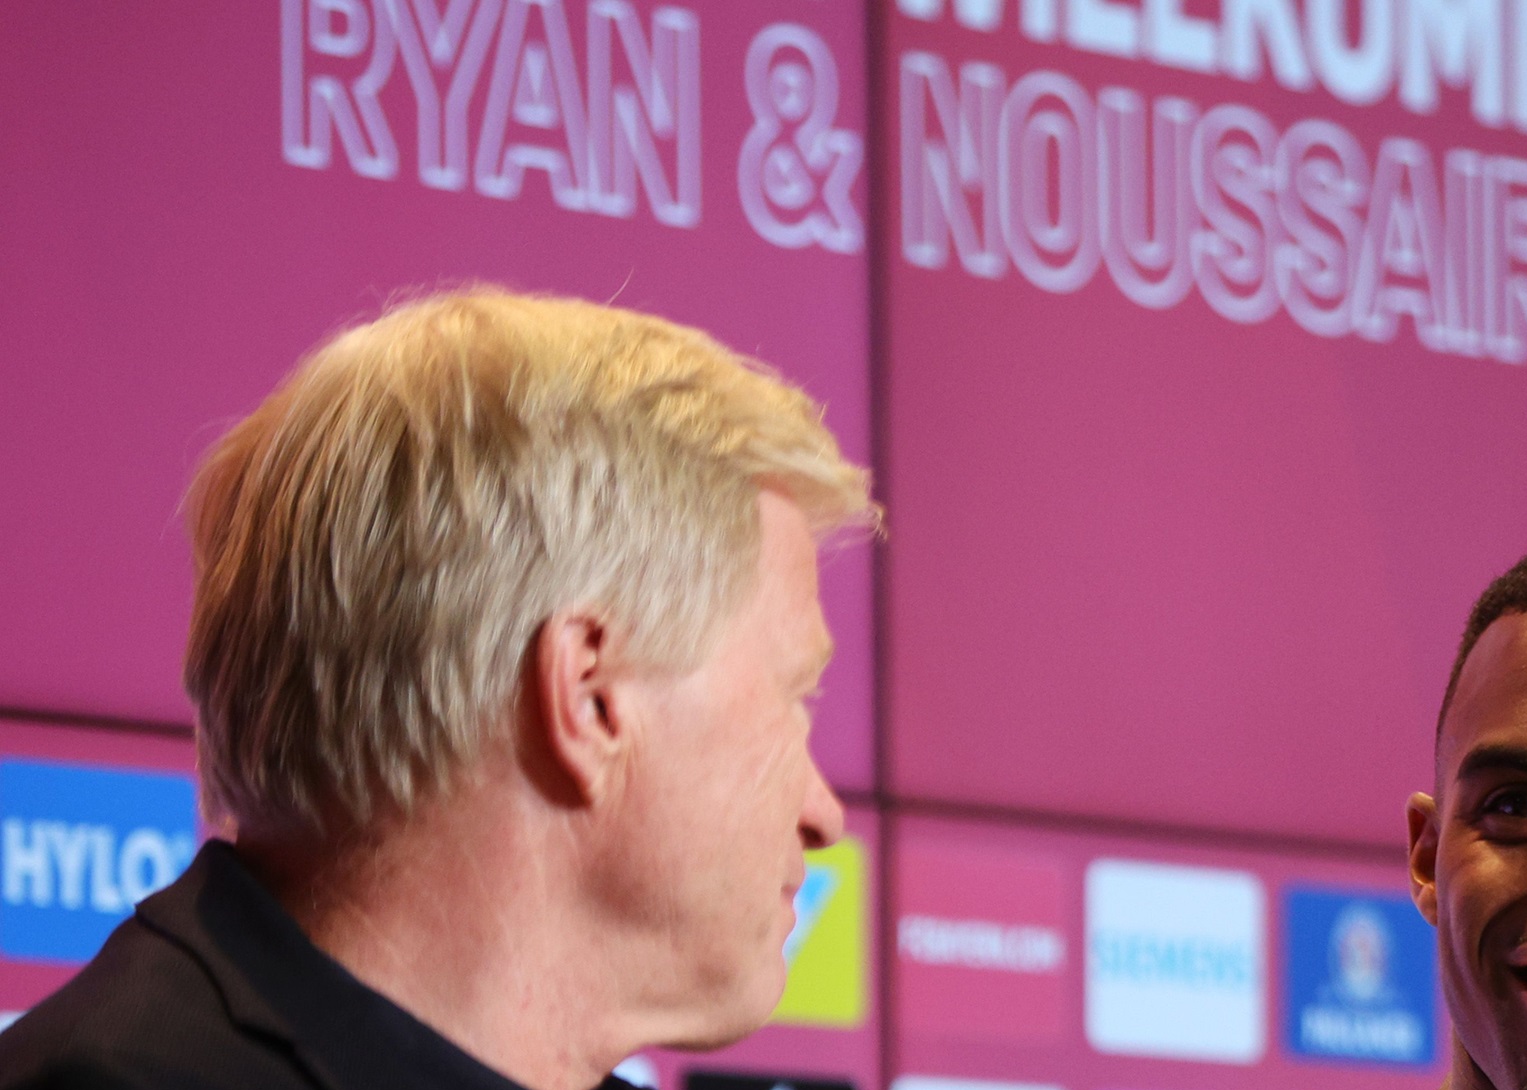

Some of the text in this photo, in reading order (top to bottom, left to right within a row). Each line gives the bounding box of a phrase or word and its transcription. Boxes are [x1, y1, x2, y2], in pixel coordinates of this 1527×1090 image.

[281, 0, 863, 254] RYAN &
[2, 818, 173, 913] HYLO
